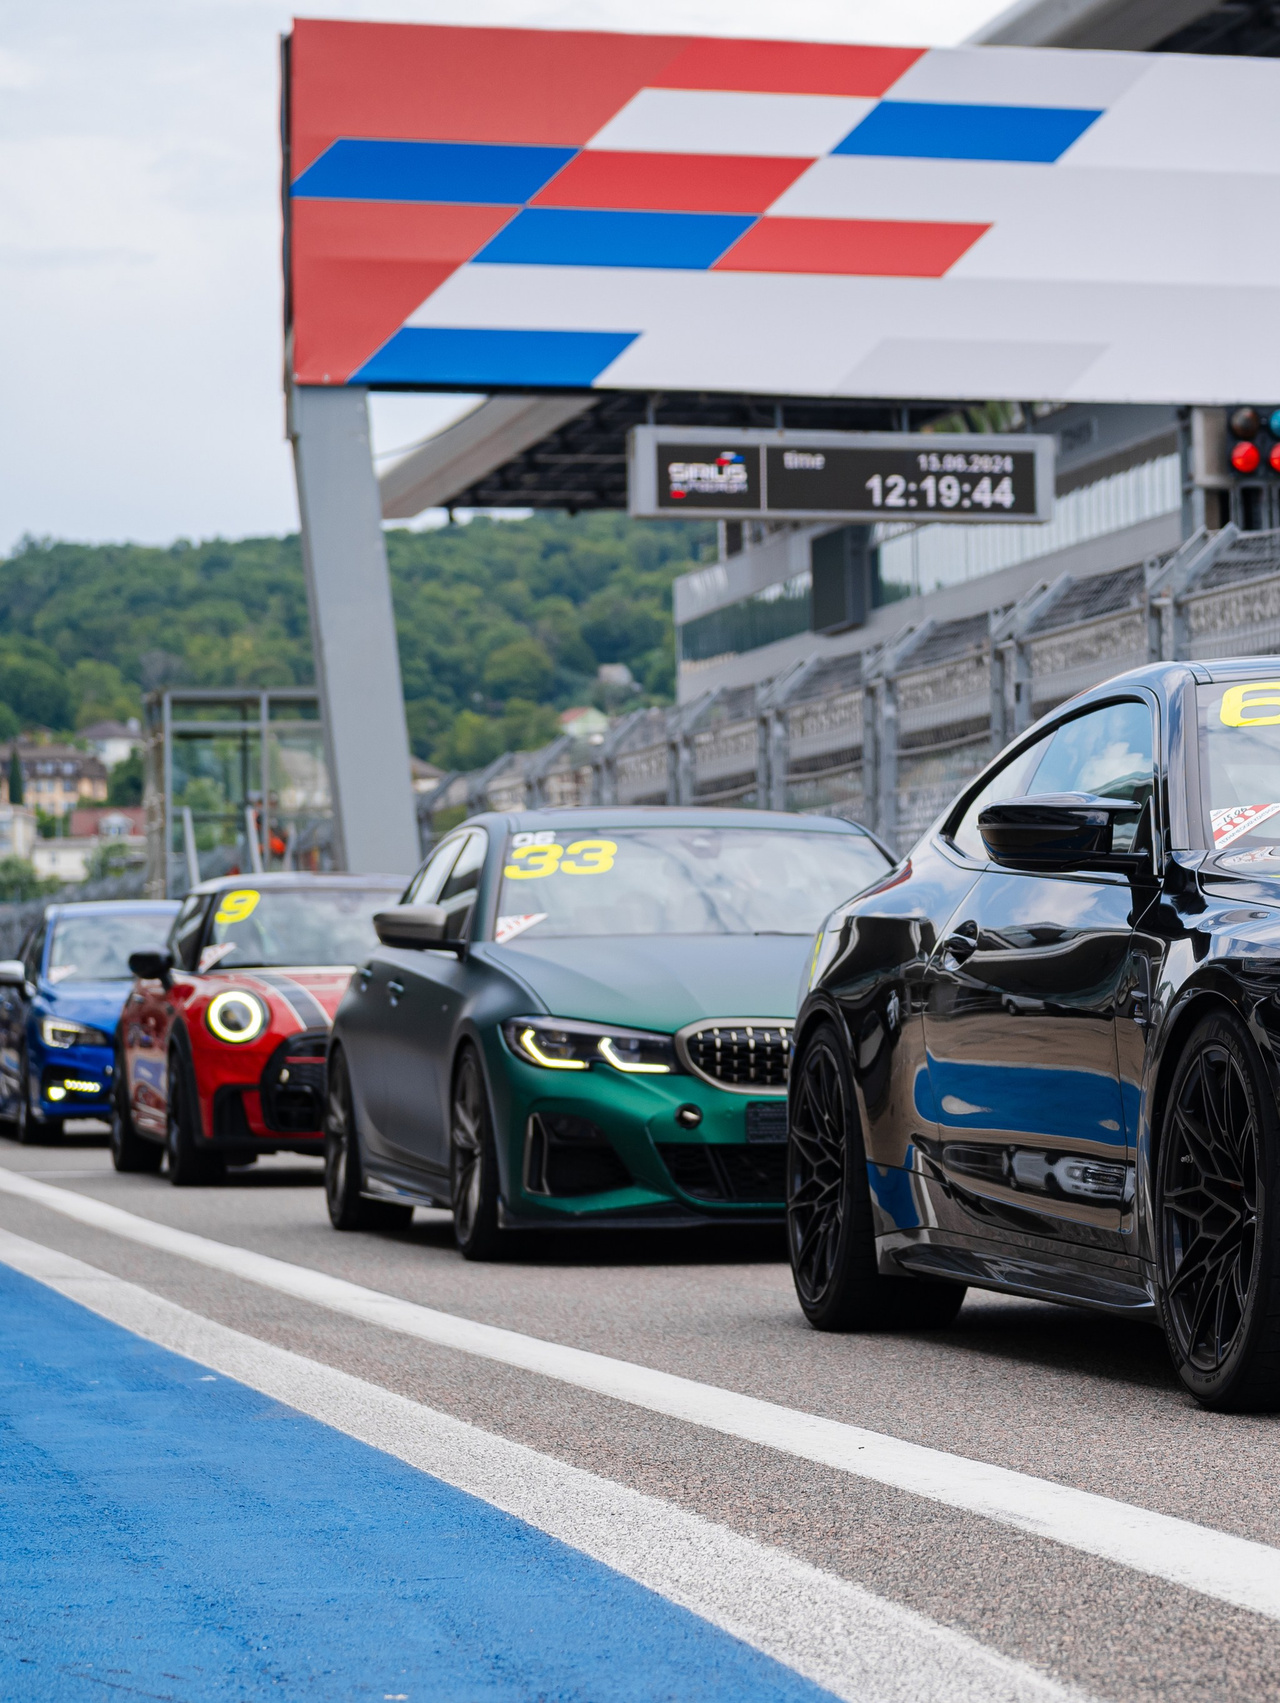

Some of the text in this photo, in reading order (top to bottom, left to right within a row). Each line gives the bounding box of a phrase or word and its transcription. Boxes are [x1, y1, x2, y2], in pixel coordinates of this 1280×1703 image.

[865, 474, 1015, 509] 12:19:44
[504, 840, 618, 880] 33
[215, 890, 261, 924] 9
